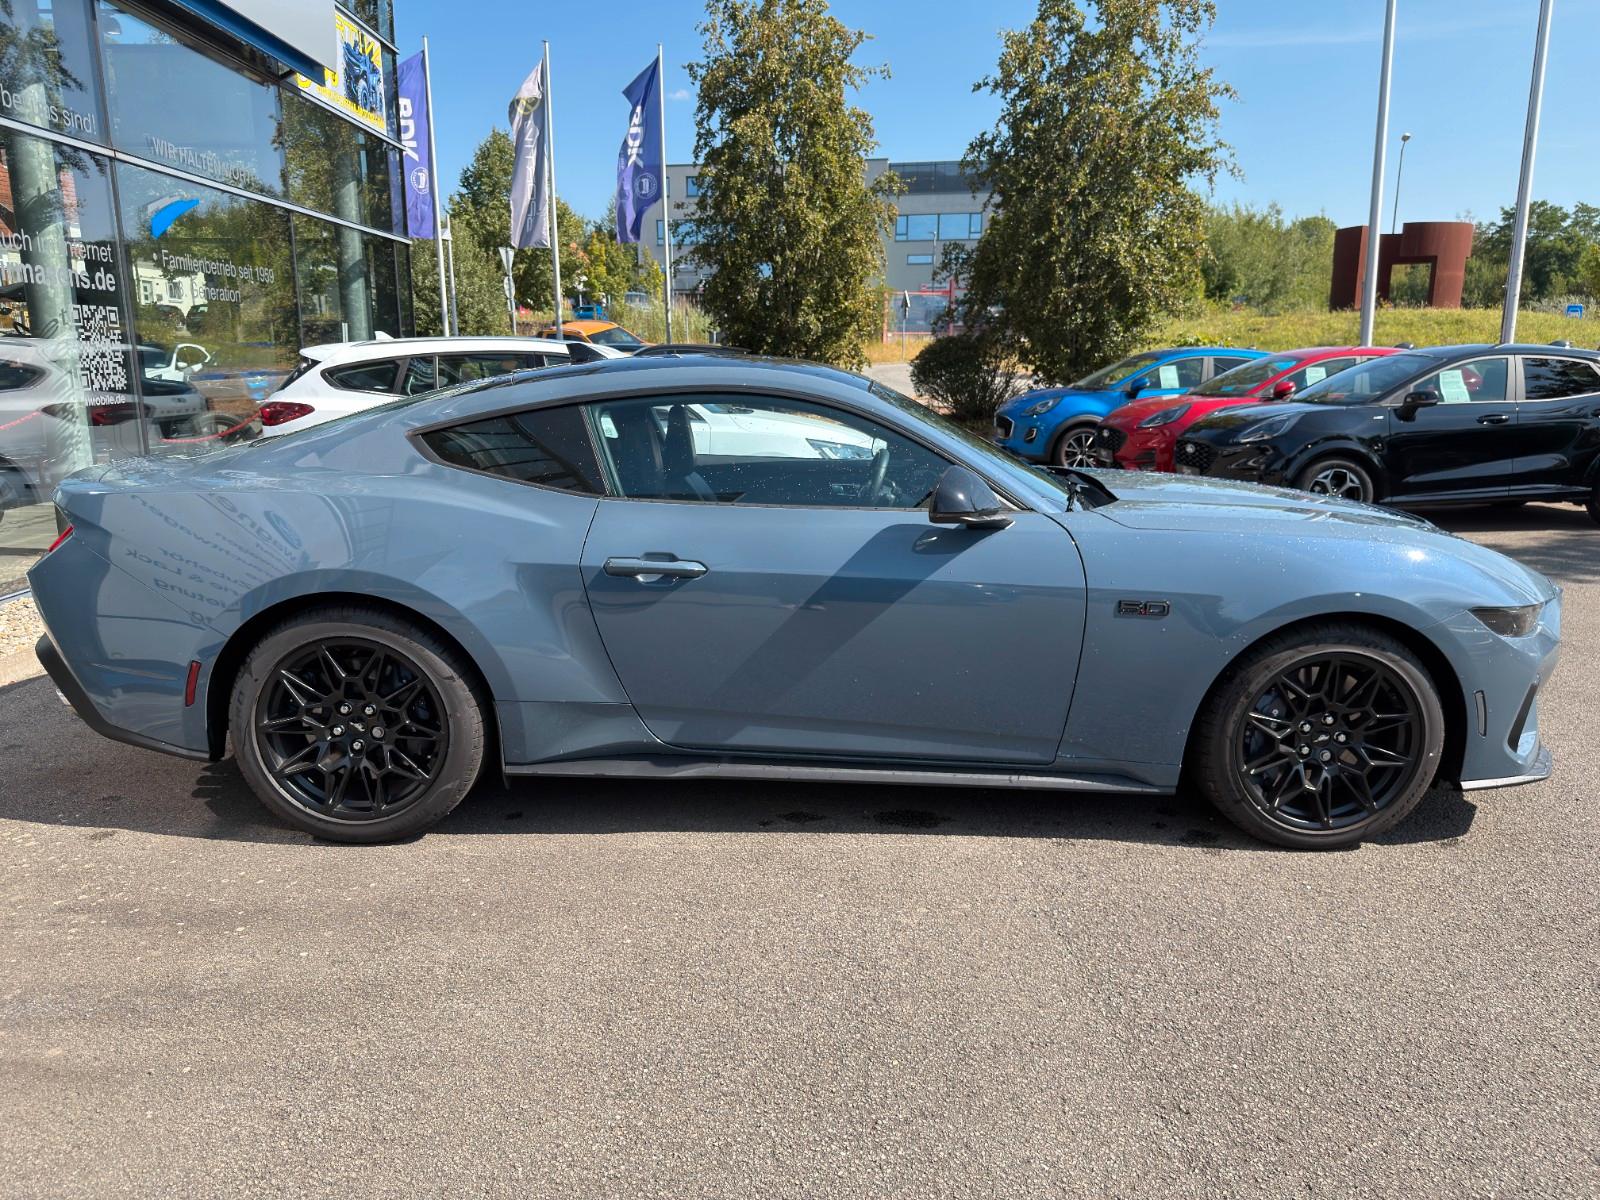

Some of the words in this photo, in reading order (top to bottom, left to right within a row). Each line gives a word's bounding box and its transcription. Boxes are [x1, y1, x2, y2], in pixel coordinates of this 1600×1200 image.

[62, 106, 97, 135] sind!
[152, 136, 176, 160] WIR
[178, 149, 221, 175] HALTEN
[0, 228, 32, 252] uch
[60, 240, 113, 263] nternet
[161, 249, 237, 278] Familienbetrieb
[238, 264, 253, 280] seit
[192, 282, 241, 302] Generation
